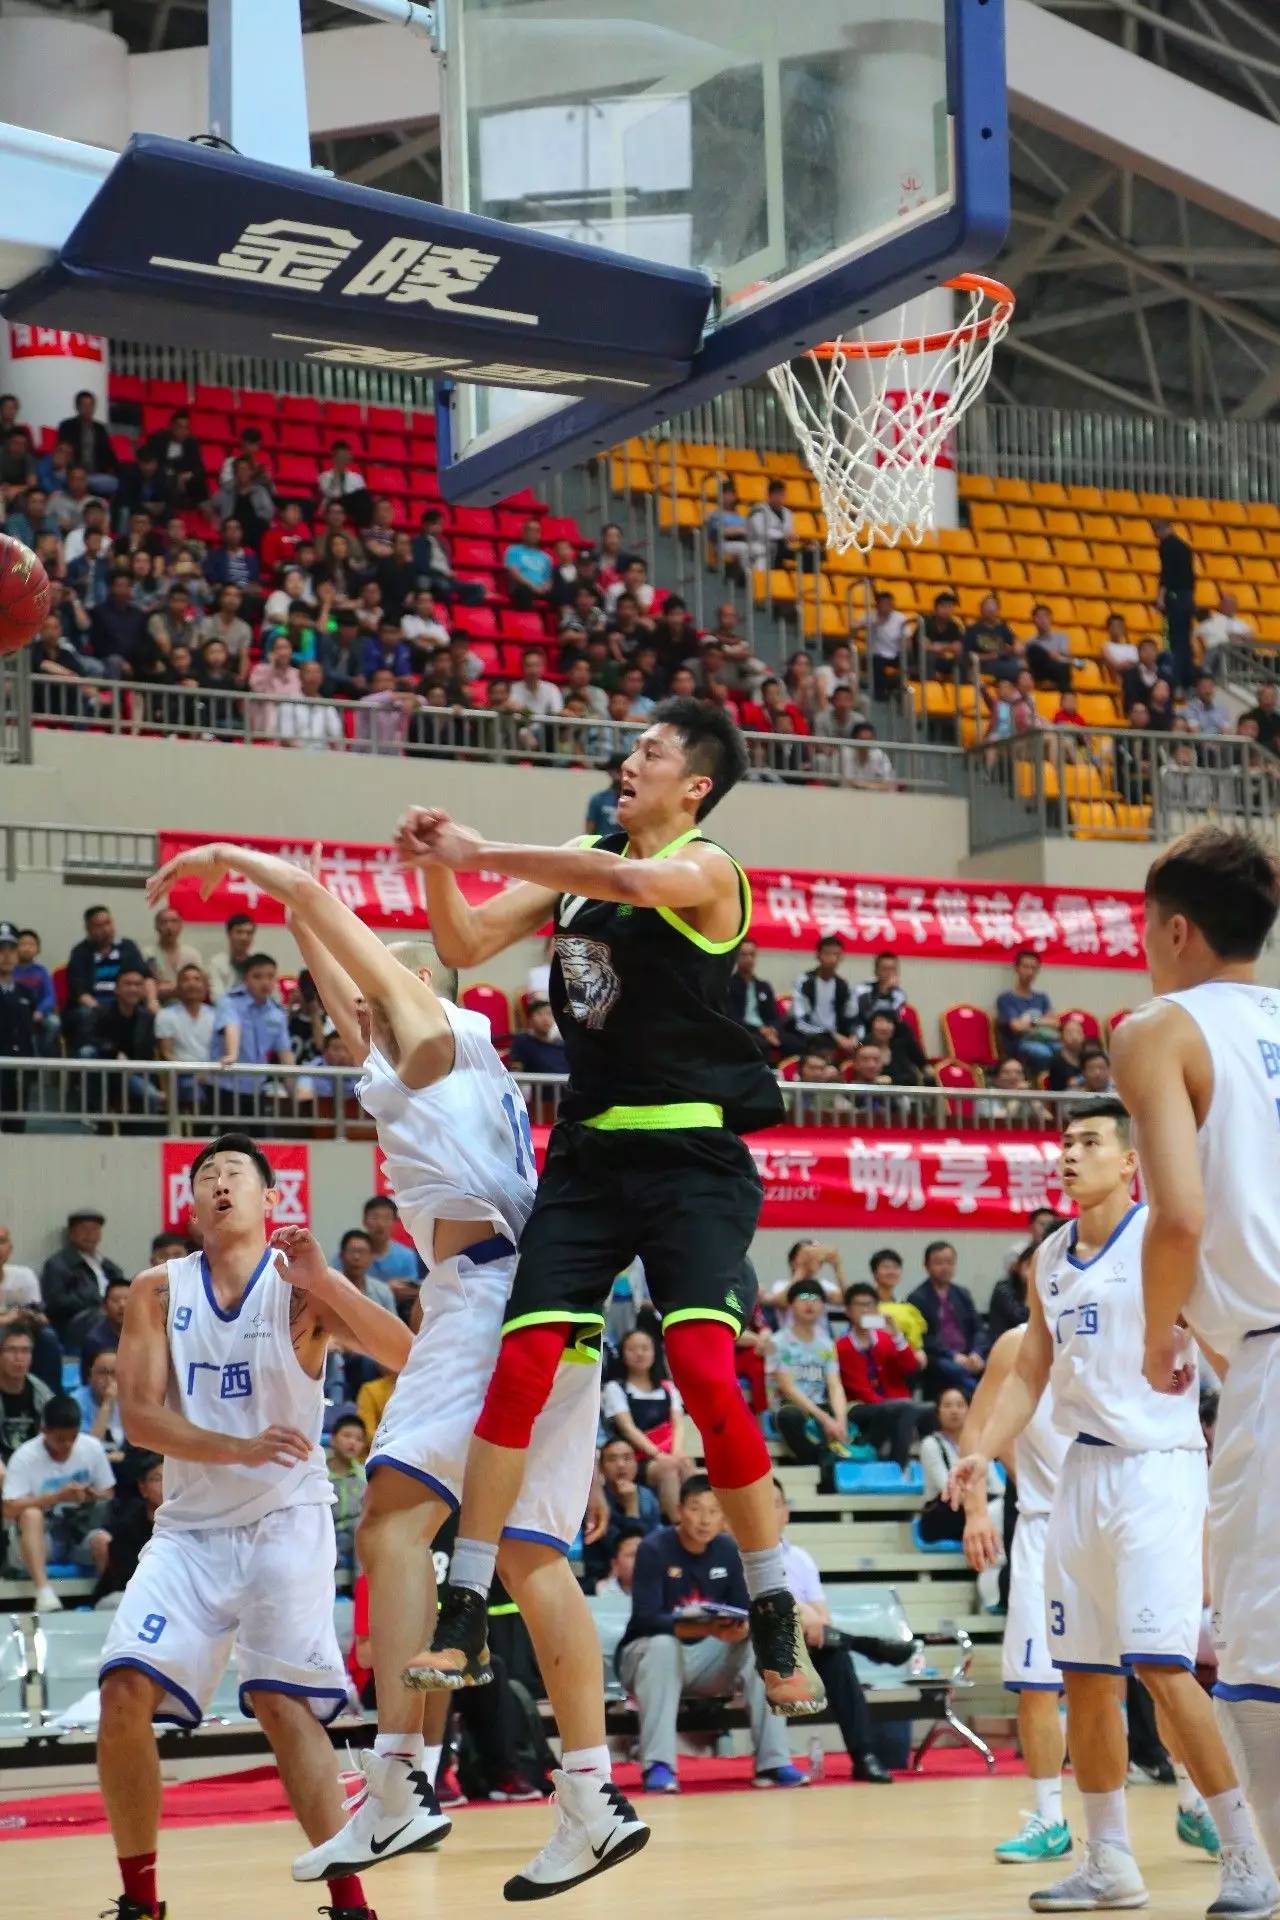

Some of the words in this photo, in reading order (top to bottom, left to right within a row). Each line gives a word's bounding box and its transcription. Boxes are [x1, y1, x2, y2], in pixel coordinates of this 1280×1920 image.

[149, 218, 539, 326] 金陵
[173, 1305, 193, 1332] 9
[186, 1361, 252, 1399] 广西
[137, 1613, 167, 1644] 9
[1050, 1600, 1065, 1637] 3
[1023, 1638, 1033, 1668] 1
